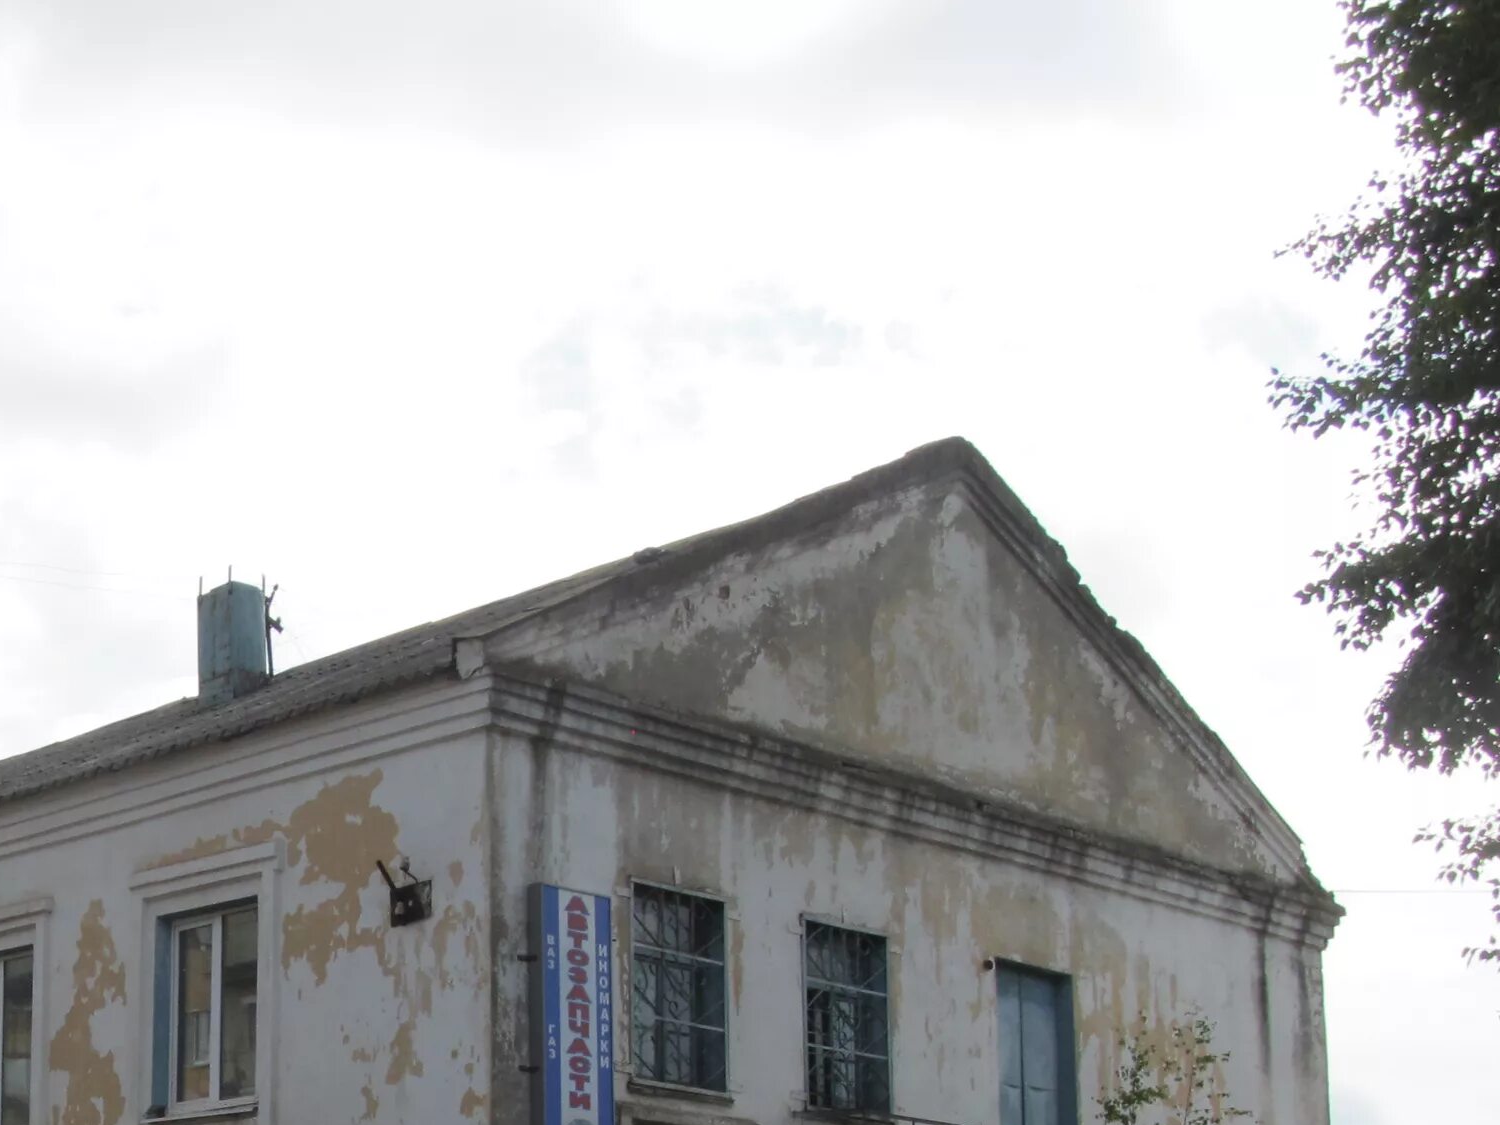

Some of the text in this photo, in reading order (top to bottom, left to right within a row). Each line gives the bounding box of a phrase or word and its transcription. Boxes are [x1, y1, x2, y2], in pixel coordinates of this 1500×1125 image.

[546, 934, 556, 970] ВАЗ
[547, 1023, 557, 1060] ГАЗ
[563, 895, 593, 1111] АВТОЗАПЧАСТИ
[598, 943, 611, 1069] ИНОМАРКИ
